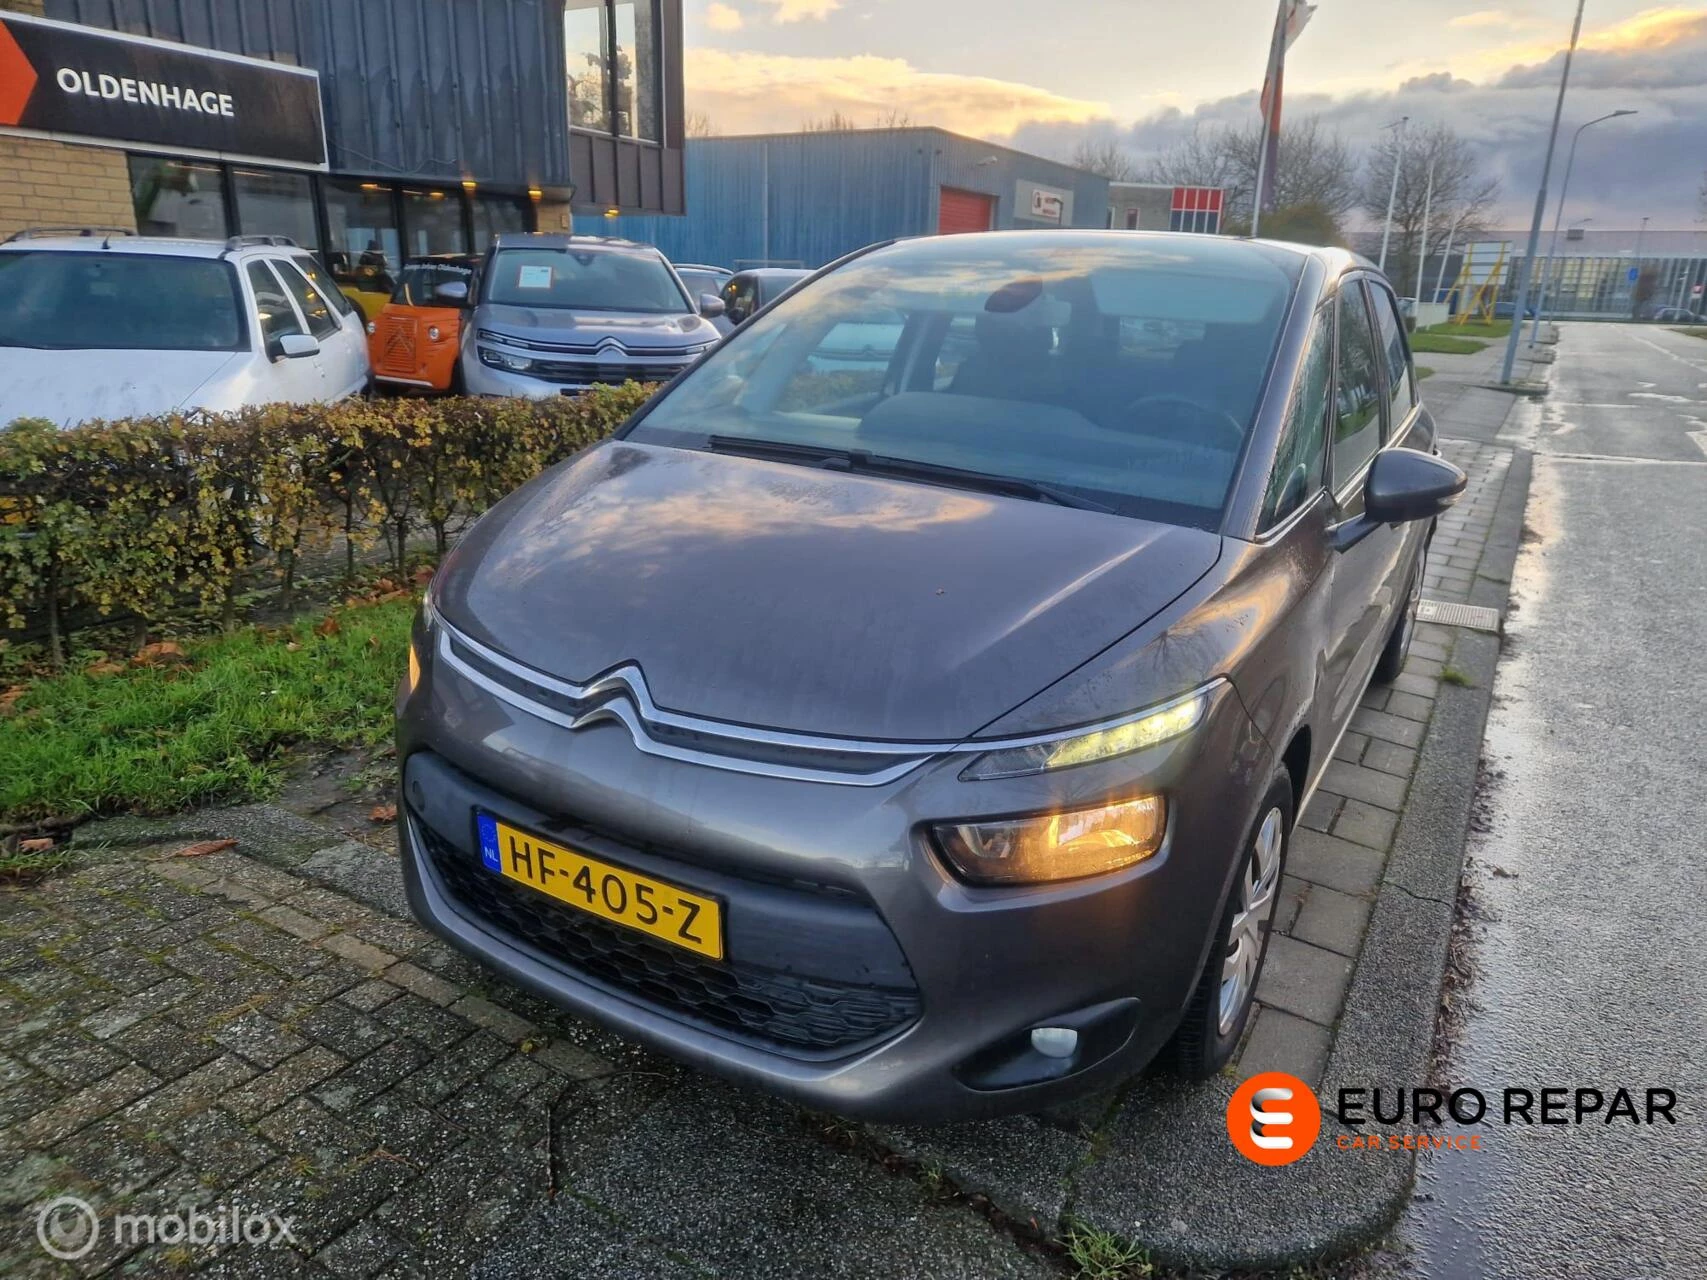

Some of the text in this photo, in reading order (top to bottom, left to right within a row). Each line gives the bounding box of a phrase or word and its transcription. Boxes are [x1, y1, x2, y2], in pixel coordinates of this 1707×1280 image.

[56, 67, 235, 117] OLDENHAGE
[484, 846, 499, 863] NL
[508, 835, 703, 945] HF-405-Z
